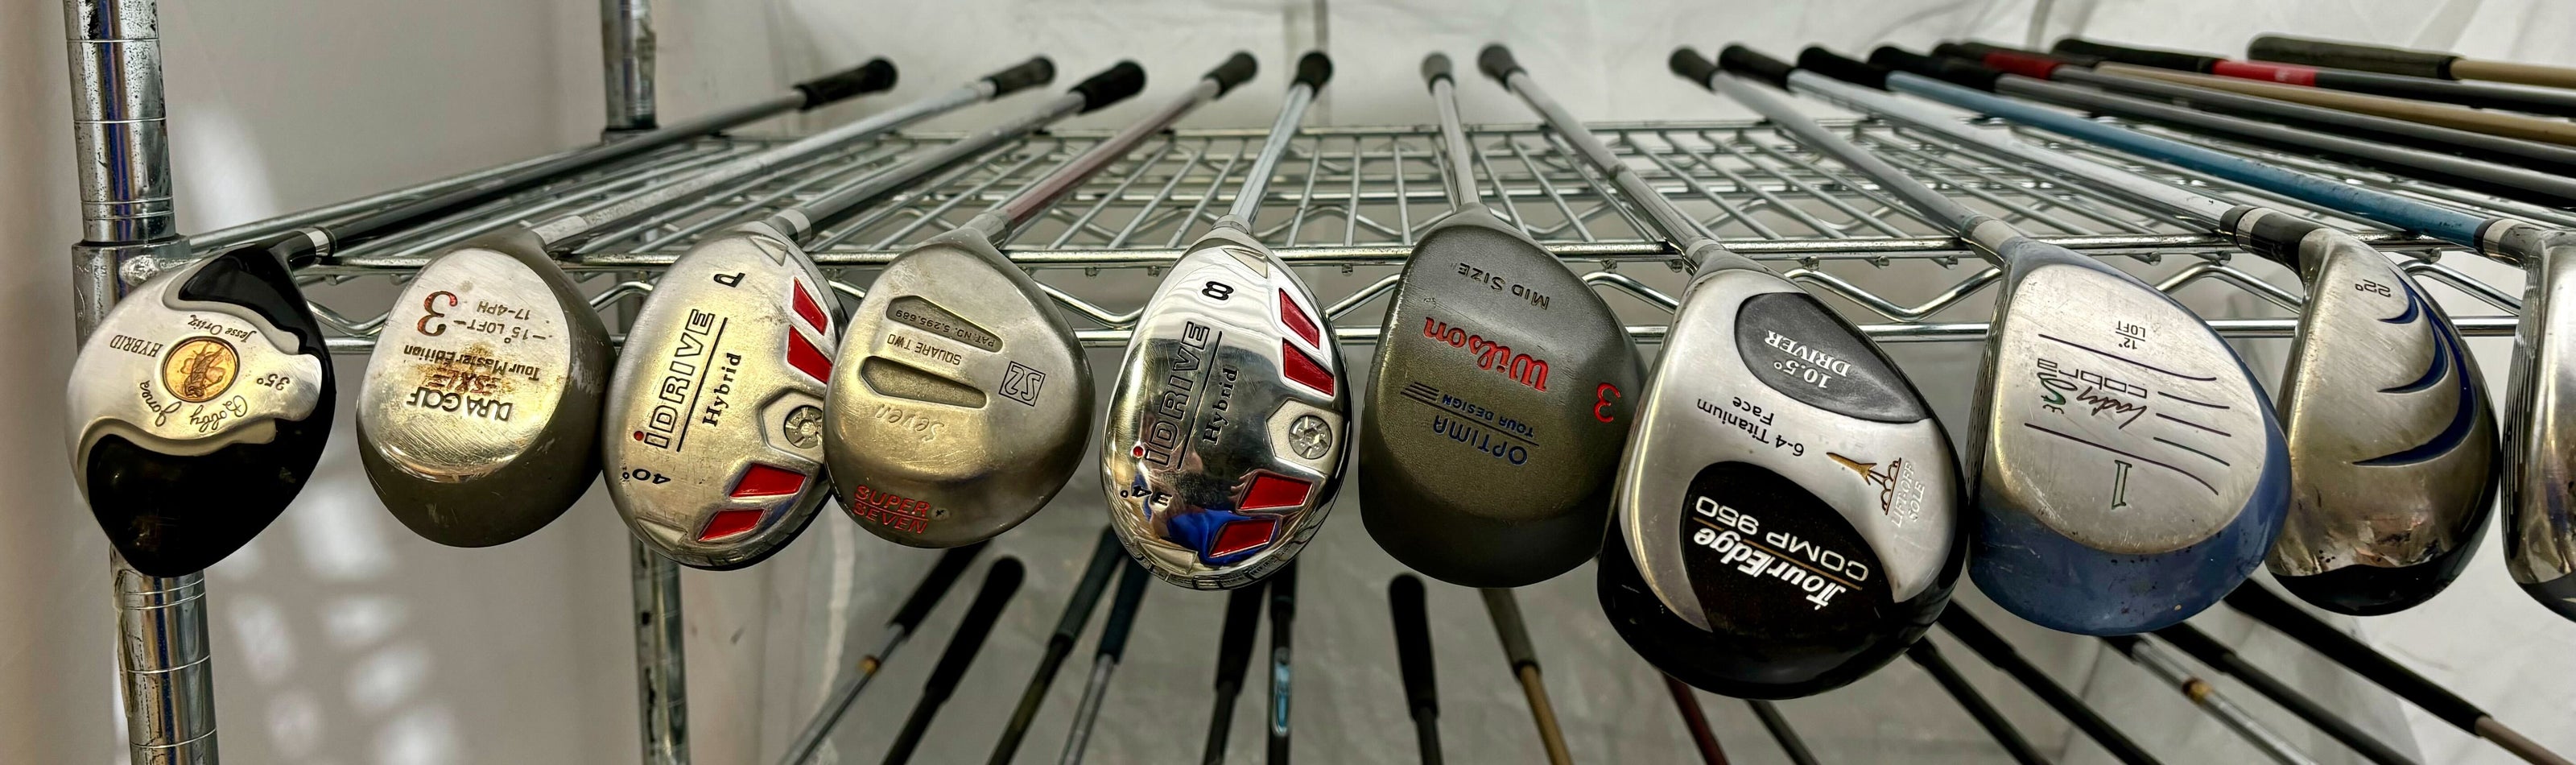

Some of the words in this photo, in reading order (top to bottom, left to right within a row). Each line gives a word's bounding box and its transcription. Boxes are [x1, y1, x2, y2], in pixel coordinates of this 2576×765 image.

[1201, 280, 1234, 301] 8
[1511, 283, 1550, 310] MID
[188, 314, 223, 336] Ortiz
[417, 291, 458, 337] 3
[477, 300, 530, 320] 17-4PH
[225, 328, 257, 343] Jesse
[887, 333, 912, 350] TWO
[2116, 320, 2146, 337] LOFT
[109, 334, 164, 358] HYBRID
[403, 345, 456, 364] Edition
[914, 341, 962, 366] SQUARE
[1423, 316, 1550, 392] Wilson
[1764, 330, 1852, 377] DRIVER
[456, 354, 508, 376] Master
[510, 362, 540, 381] Tour
[634, 308, 716, 449] iDRIVE
[1773, 360, 1832, 389] 10.5°
[140, 379, 182, 427] Jones
[407, 386, 462, 412] GOLF
[702, 353, 742, 427] Hybrid
[1202, 366, 1238, 445] Hybrid
[1593, 382, 1621, 423] 3
[190, 395, 248, 432] Bobby
[466, 395, 514, 422] DURA
[875, 403, 945, 442] Seven
[1441, 394, 1493, 422] DESIGN
[1696, 399, 1770, 445] Titanium
[1732, 396, 1775, 426] Face
[1433, 415, 1528, 465] OPTIMA
[1498, 416, 1534, 438] TOUR
[1775, 435, 1805, 457] 6-4
[1891, 460, 1916, 528] LIFT-OFF
[2111, 459, 2132, 510] 1
[854, 484, 931, 517] SUPER
[1695, 495, 1760, 536] 950
[1907, 480, 1926, 523] SOLE
[852, 501, 927, 534] SEVEN
[1765, 531, 1869, 582] COMP
